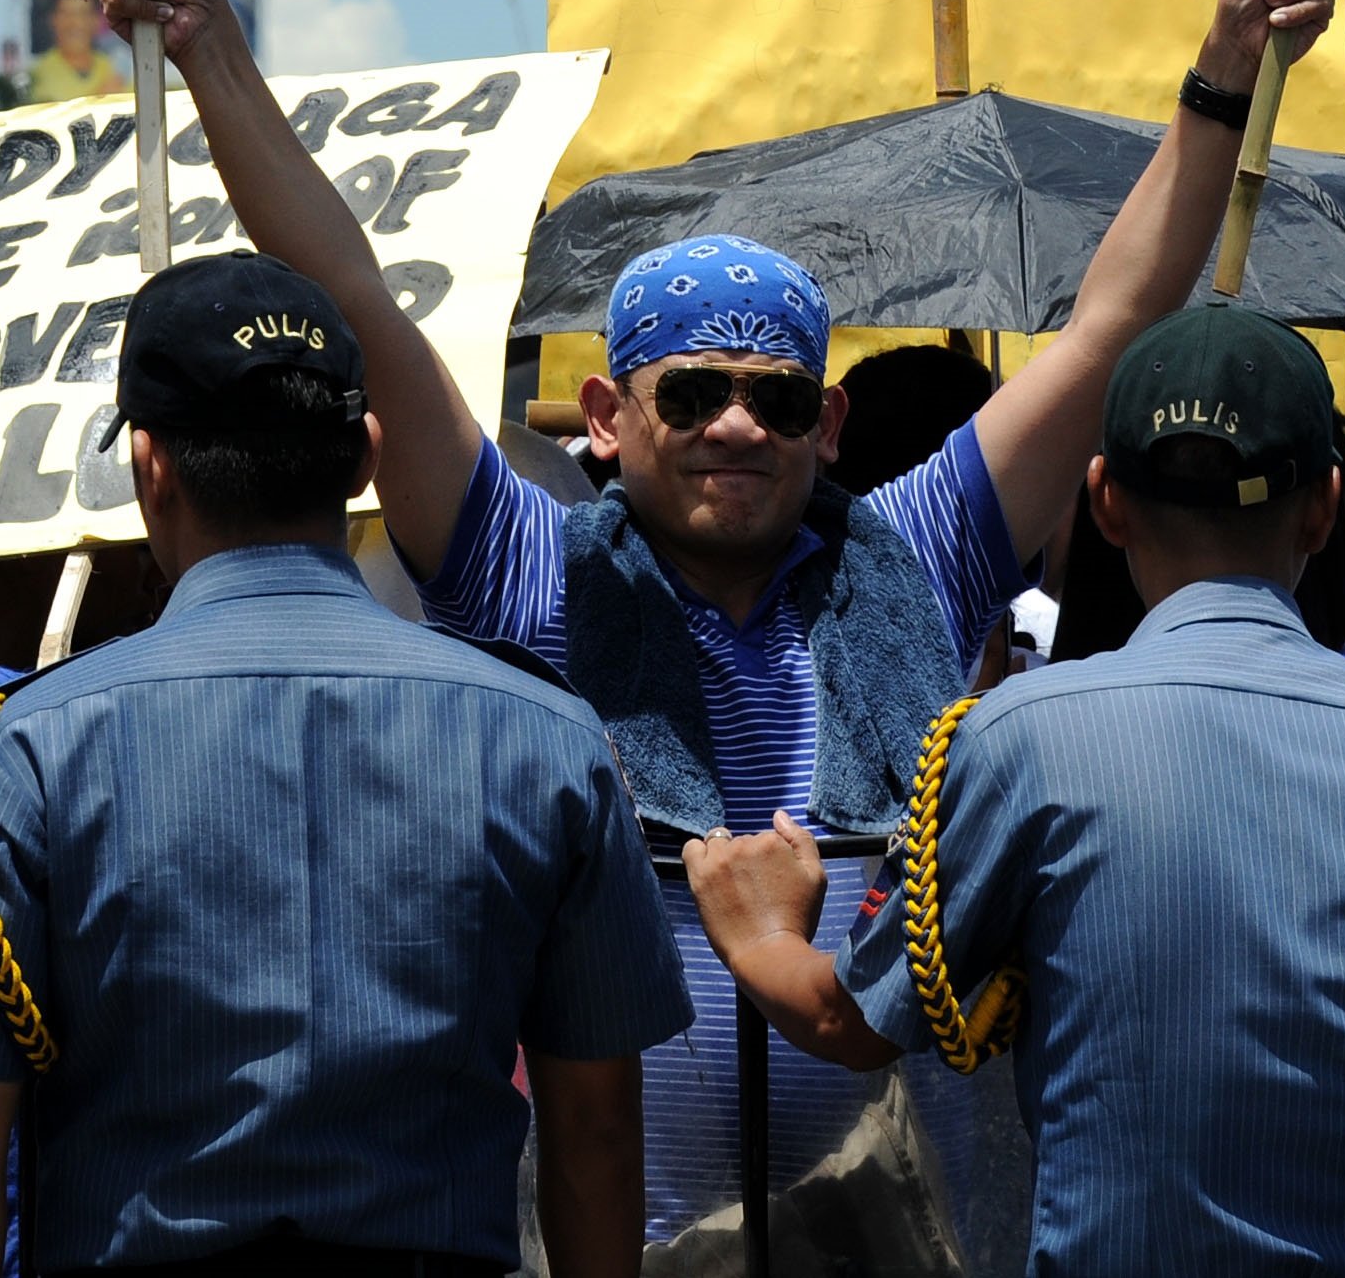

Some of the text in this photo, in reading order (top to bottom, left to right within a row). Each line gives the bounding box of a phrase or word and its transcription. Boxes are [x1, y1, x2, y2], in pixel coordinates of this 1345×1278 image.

[333, 148, 471, 235] OF
[232, 313, 325, 351] PULIS
[1152, 399, 1239, 435] PULIS
